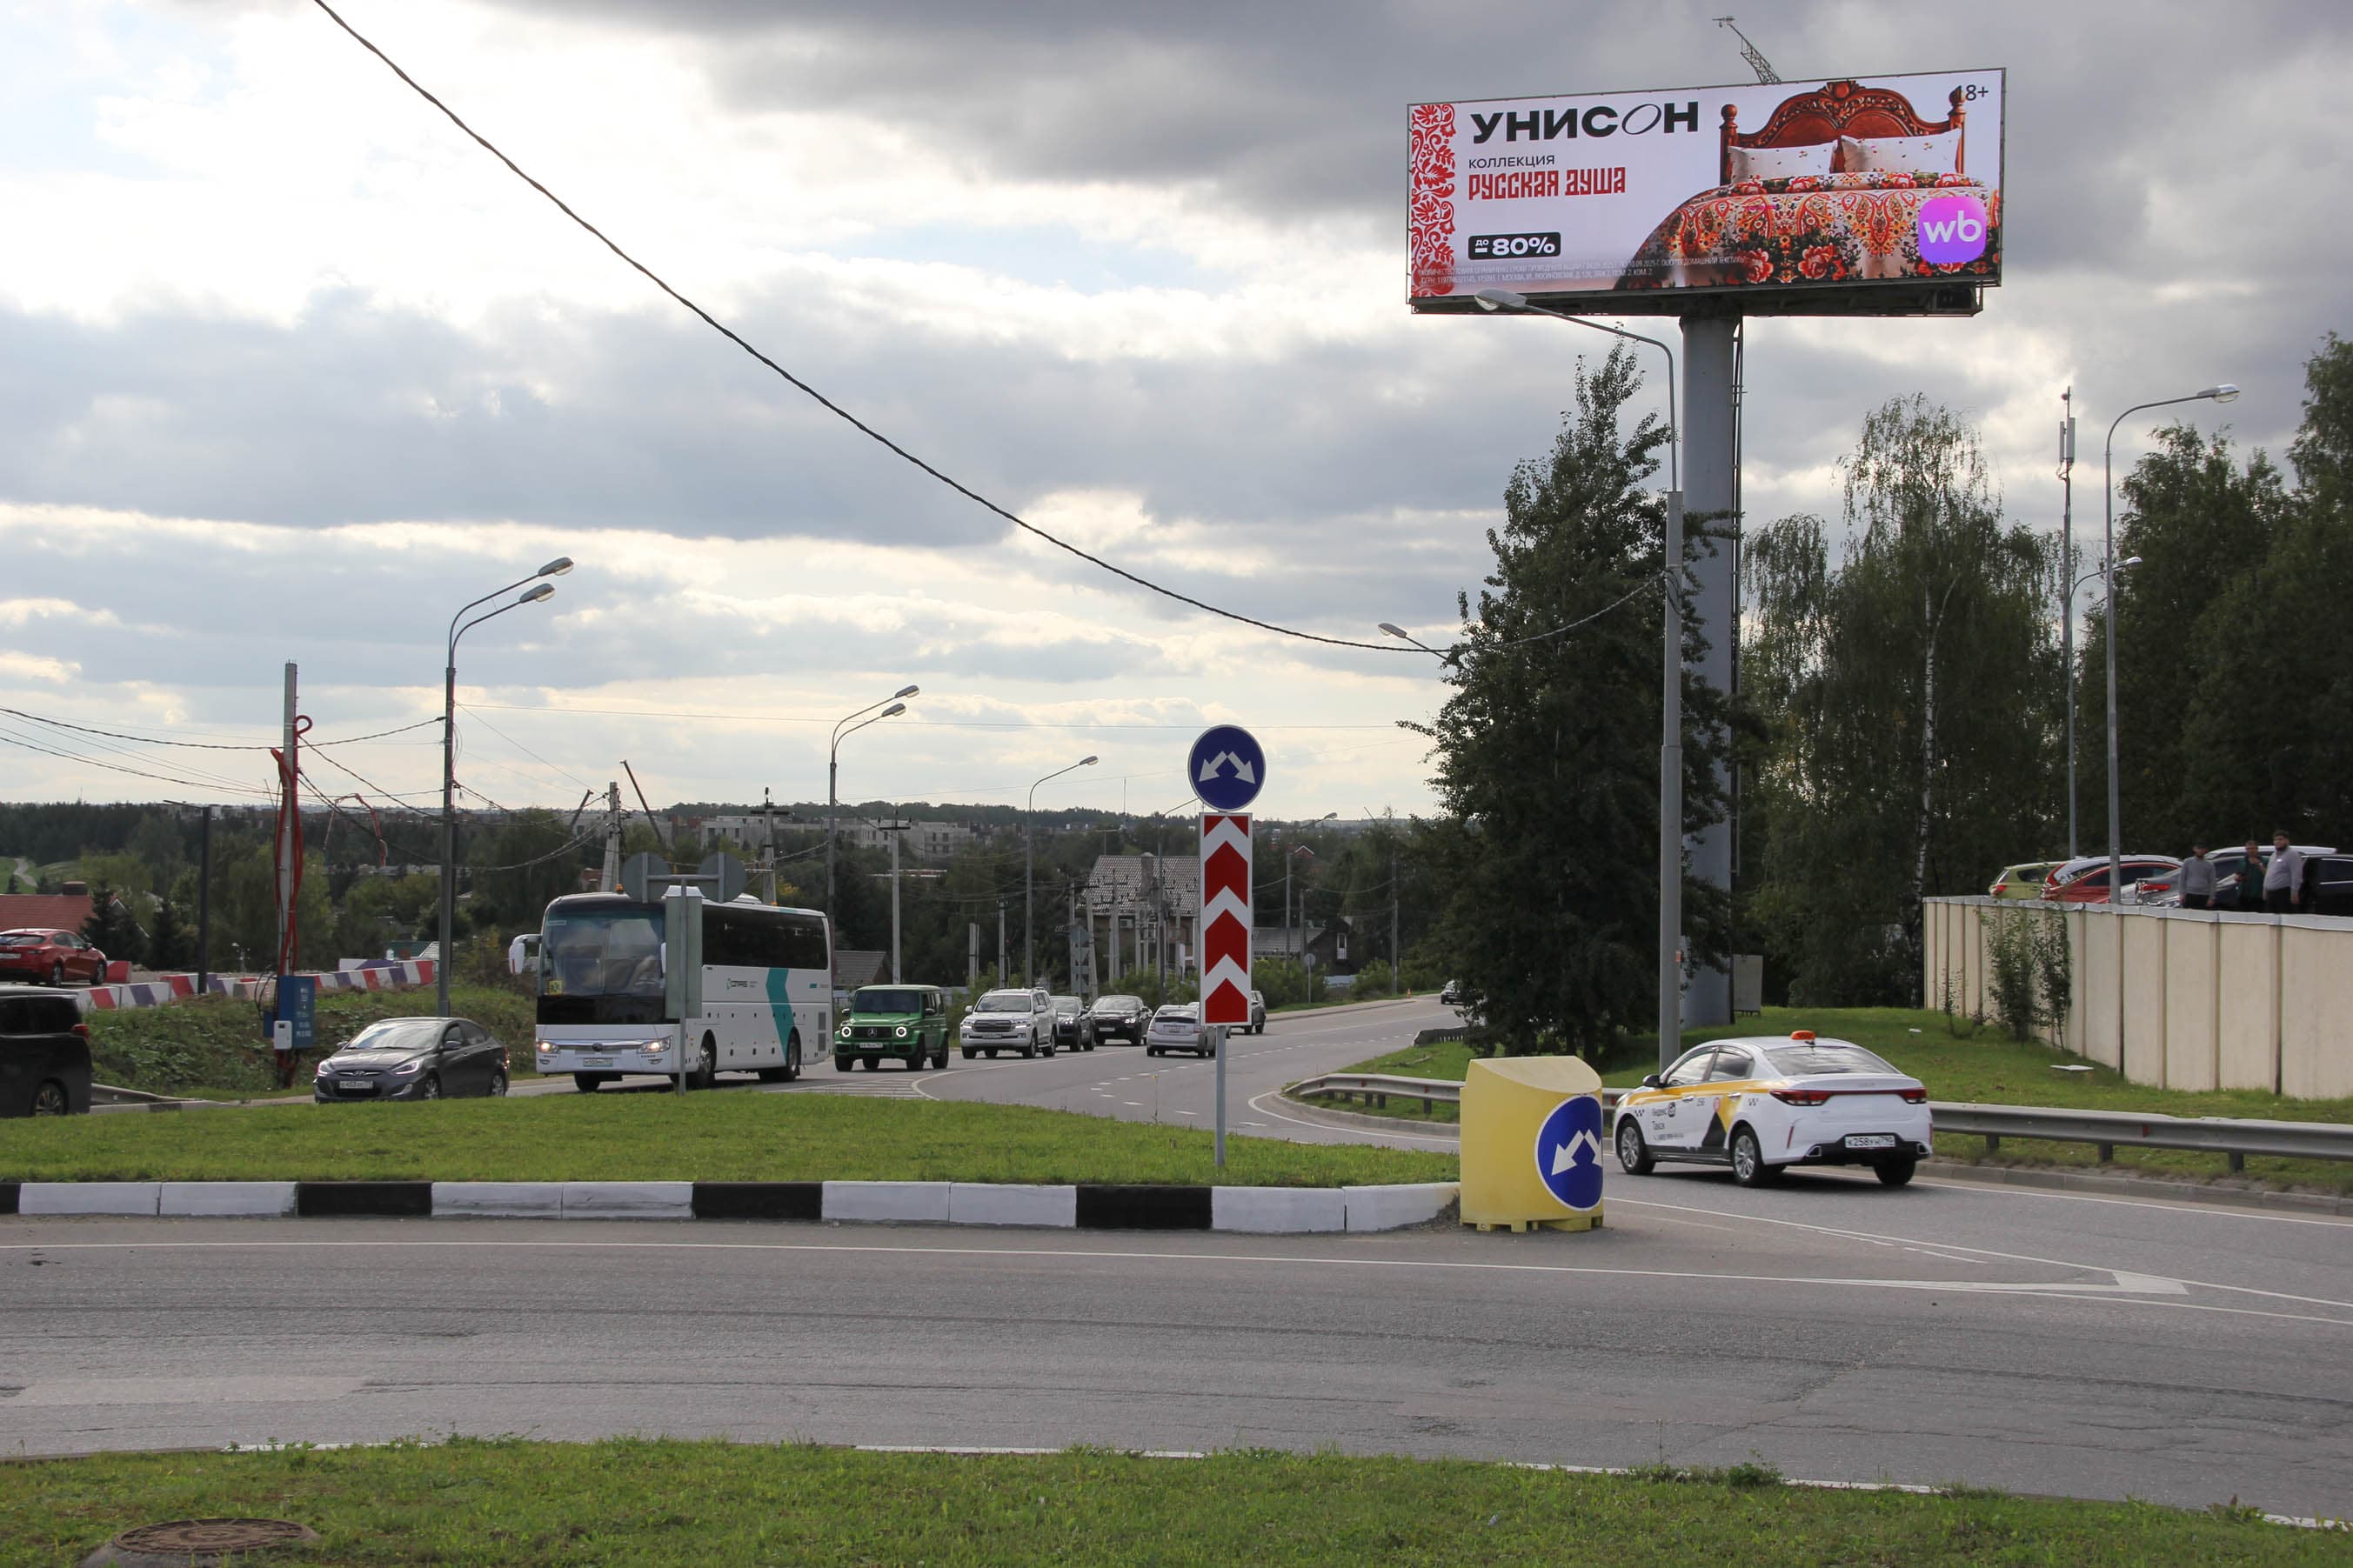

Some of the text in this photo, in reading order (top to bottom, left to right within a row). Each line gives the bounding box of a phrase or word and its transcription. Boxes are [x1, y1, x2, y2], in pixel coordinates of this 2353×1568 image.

[1470, 101, 1699, 144] УНИСОН
[1468, 155, 1555, 169] КОЛЛЕКЦИЯ
[1468, 167, 1626, 200] РУССКАЯ ДУША
[1922, 210, 1982, 244] wb
